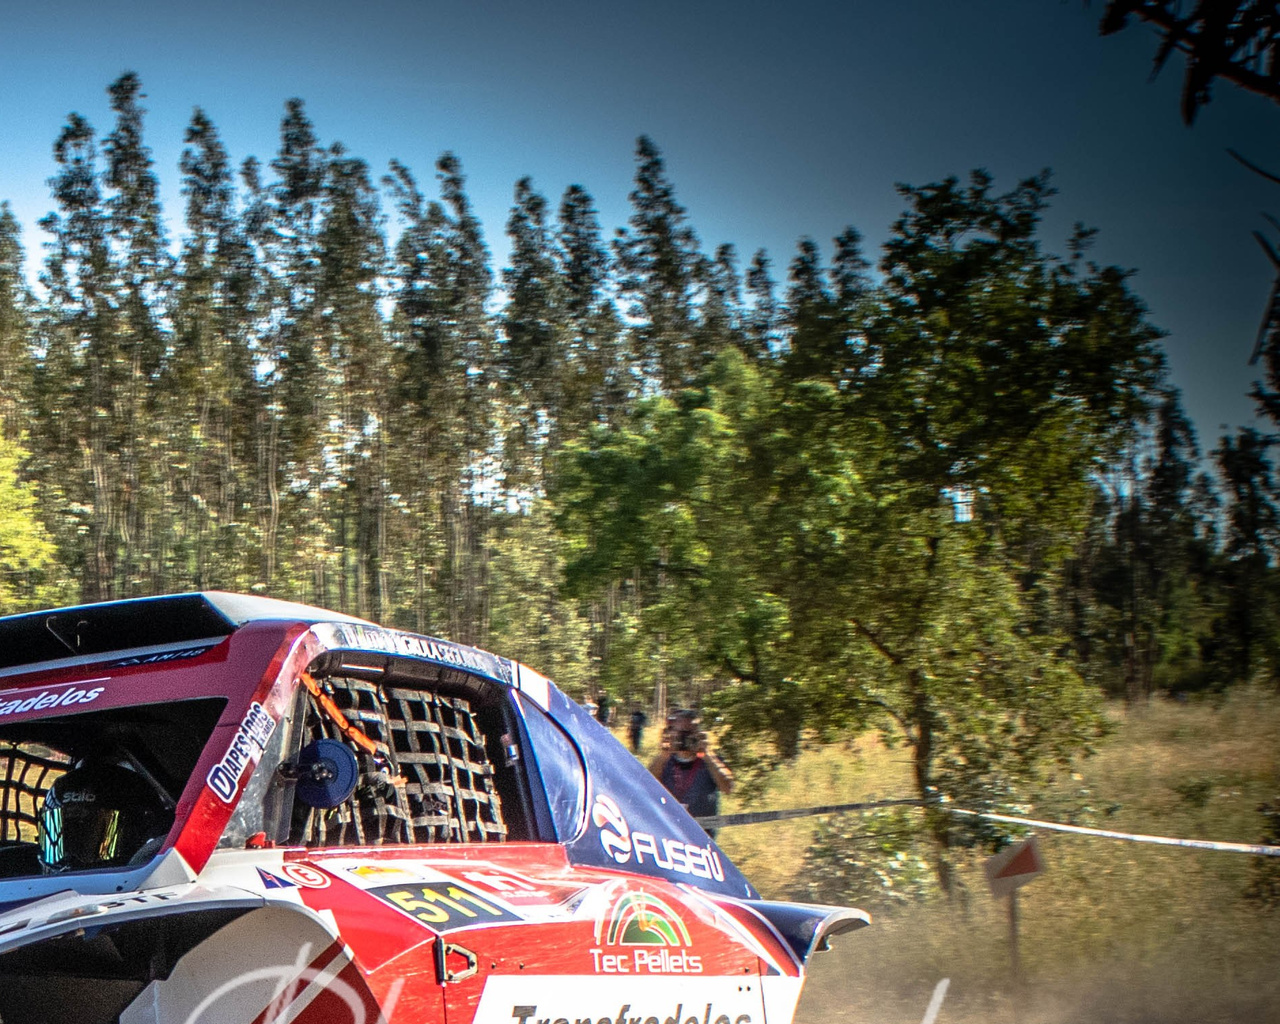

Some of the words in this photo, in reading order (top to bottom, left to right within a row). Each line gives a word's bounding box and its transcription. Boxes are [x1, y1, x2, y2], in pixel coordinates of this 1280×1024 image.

[631, 831, 725, 882] FUSEN
[385, 886, 503, 923] 511
[589, 949, 630, 973] Tec
[634, 949, 704, 973] Pellets
